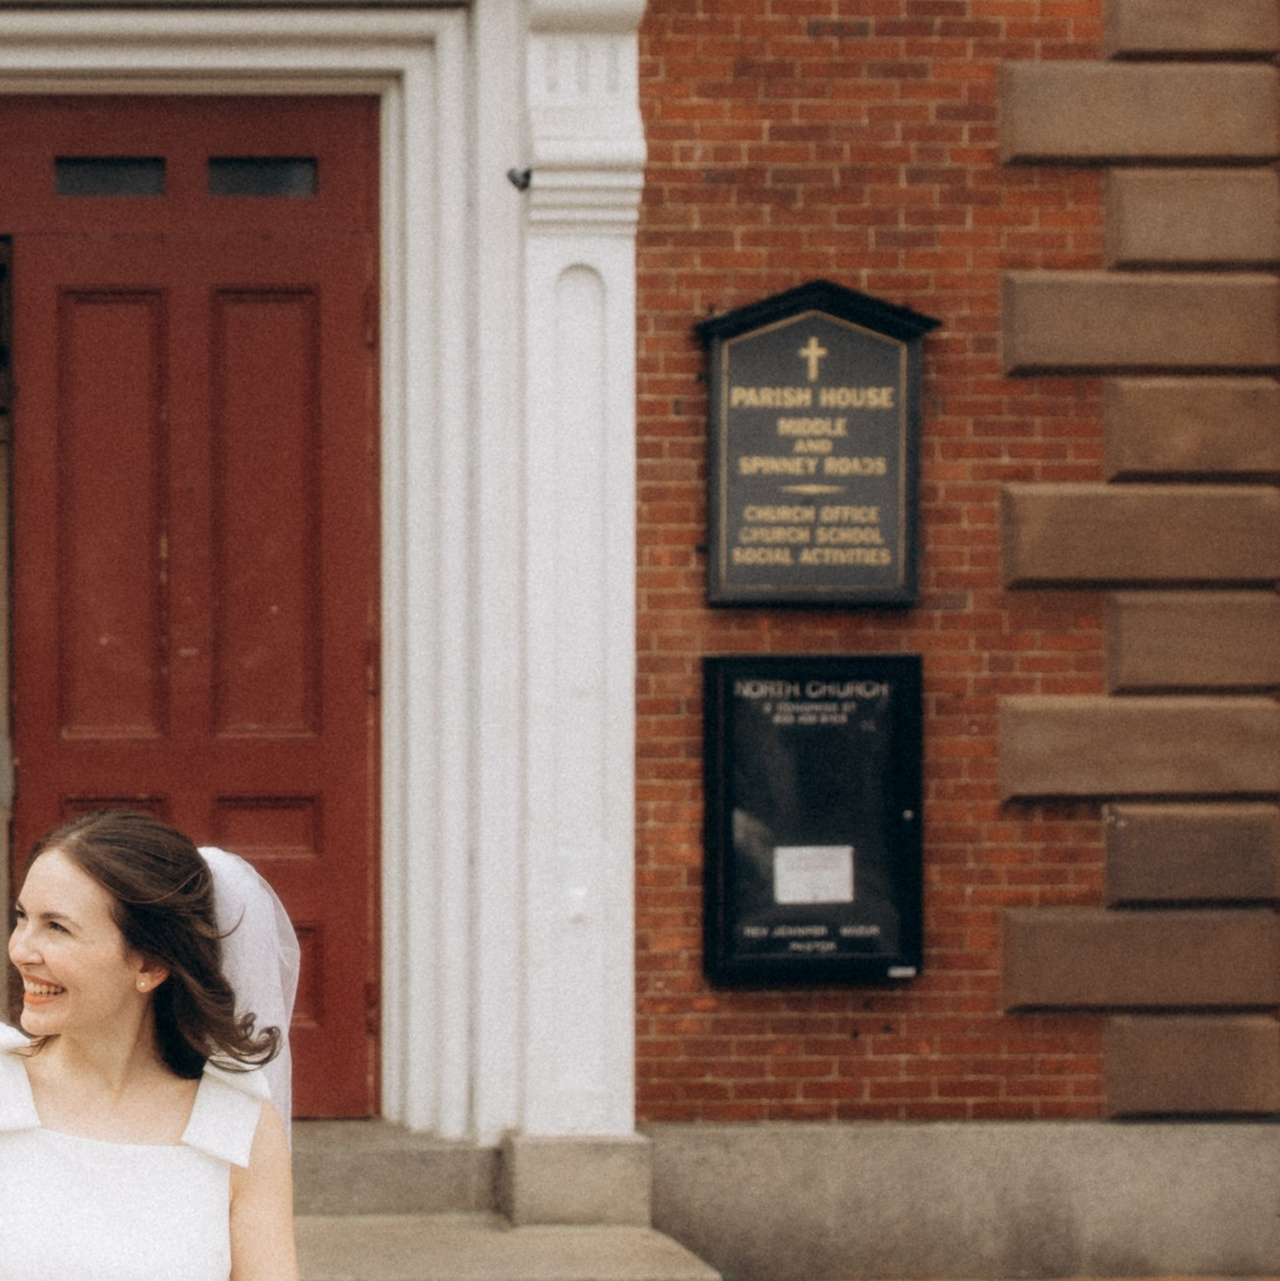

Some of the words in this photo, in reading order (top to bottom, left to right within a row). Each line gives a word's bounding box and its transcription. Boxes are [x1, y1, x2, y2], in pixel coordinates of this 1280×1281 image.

[730, 386, 813, 409] PARISH
[819, 386, 896, 409] HOUSE
[776, 417, 848, 437] MIDDLE
[792, 438, 834, 454] AND
[738, 456, 819, 475] SPINNEY
[823, 456, 887, 475] ROADS
[743, 505, 816, 522] CHURCH
[819, 505, 881, 523] OFFICE
[738, 526, 811, 544] CHURCH
[815, 526, 885, 545] SCHOOL
[732, 547, 793, 565] SOCIAL
[798, 547, 891, 566] ACTIVITIES
[733, 680, 801, 699] NORTH
[805, 680, 889, 699] CHURCH
